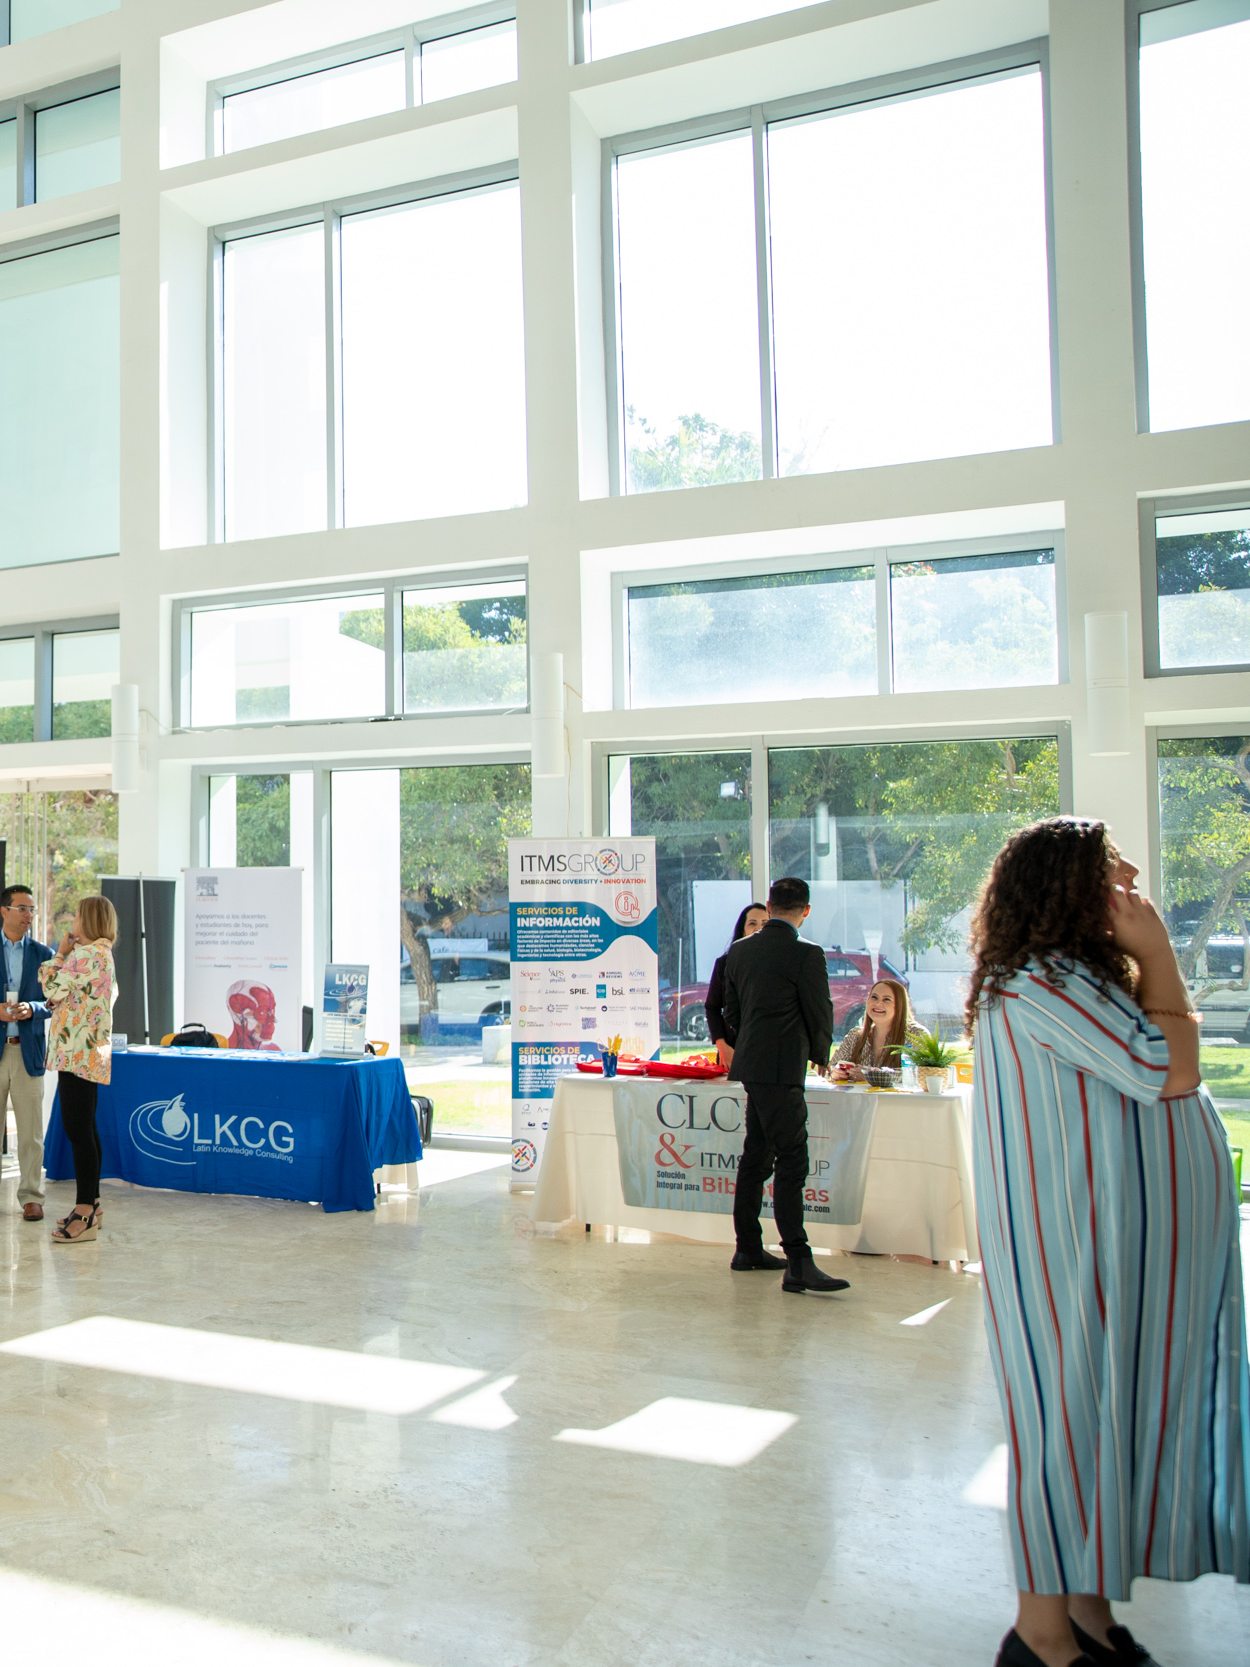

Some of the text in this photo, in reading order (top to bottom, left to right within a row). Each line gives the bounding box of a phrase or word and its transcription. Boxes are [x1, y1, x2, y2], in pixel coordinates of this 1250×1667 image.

[517, 915, 600, 927] INFORMACIÓN
[335, 973, 367, 986] LKCG
[568, 1046, 580, 1054] DE
[519, 1054, 595, 1065] BIBLIOTECA
[656, 1093, 741, 1132] CLC
[193, 1112, 294, 1153] LKCG
[193, 1144, 293, 1163] Latin Knowledge Consulting
[654, 1132, 696, 1169] &
[657, 1170, 685, 1180] Solución
[657, 1181, 682, 1190] Integral
[684, 1182, 699, 1191] para
